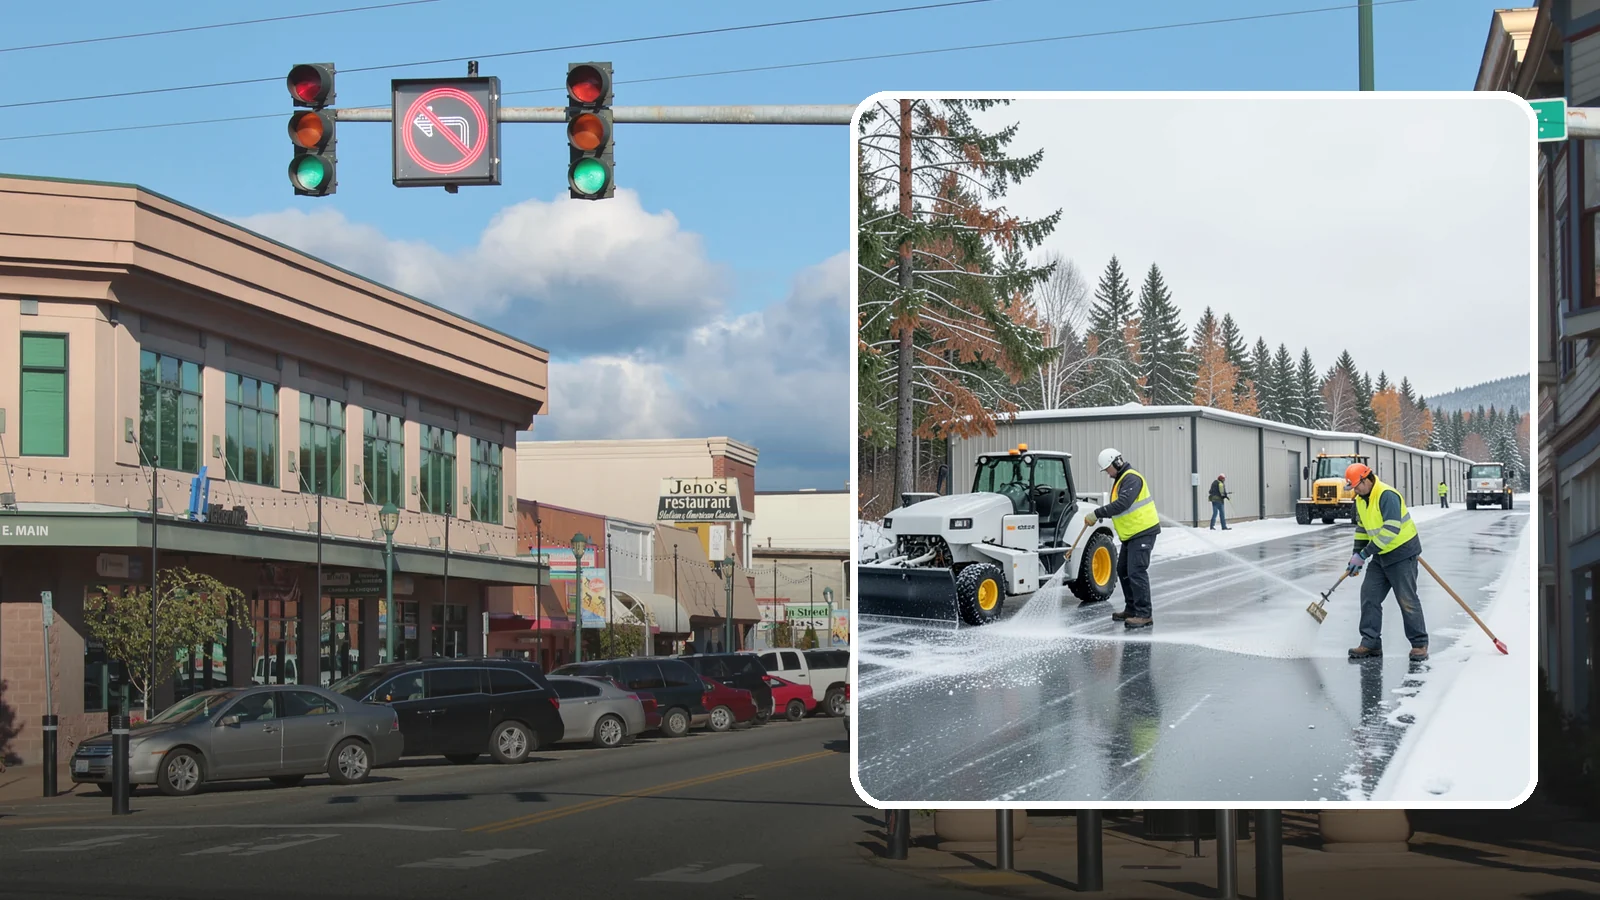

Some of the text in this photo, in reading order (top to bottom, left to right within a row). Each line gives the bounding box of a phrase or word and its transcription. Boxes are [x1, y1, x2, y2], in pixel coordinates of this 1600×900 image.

[670, 480, 727, 494] Jeno's
[665, 496, 731, 509] restaurant
[658, 510, 682, 520] Italian
[685, 510, 715, 520] American
[715, 509, 738, 519] Cuisine
[2, 525, 49, 536] E. MAIN
[797, 607, 829, 617] Street
